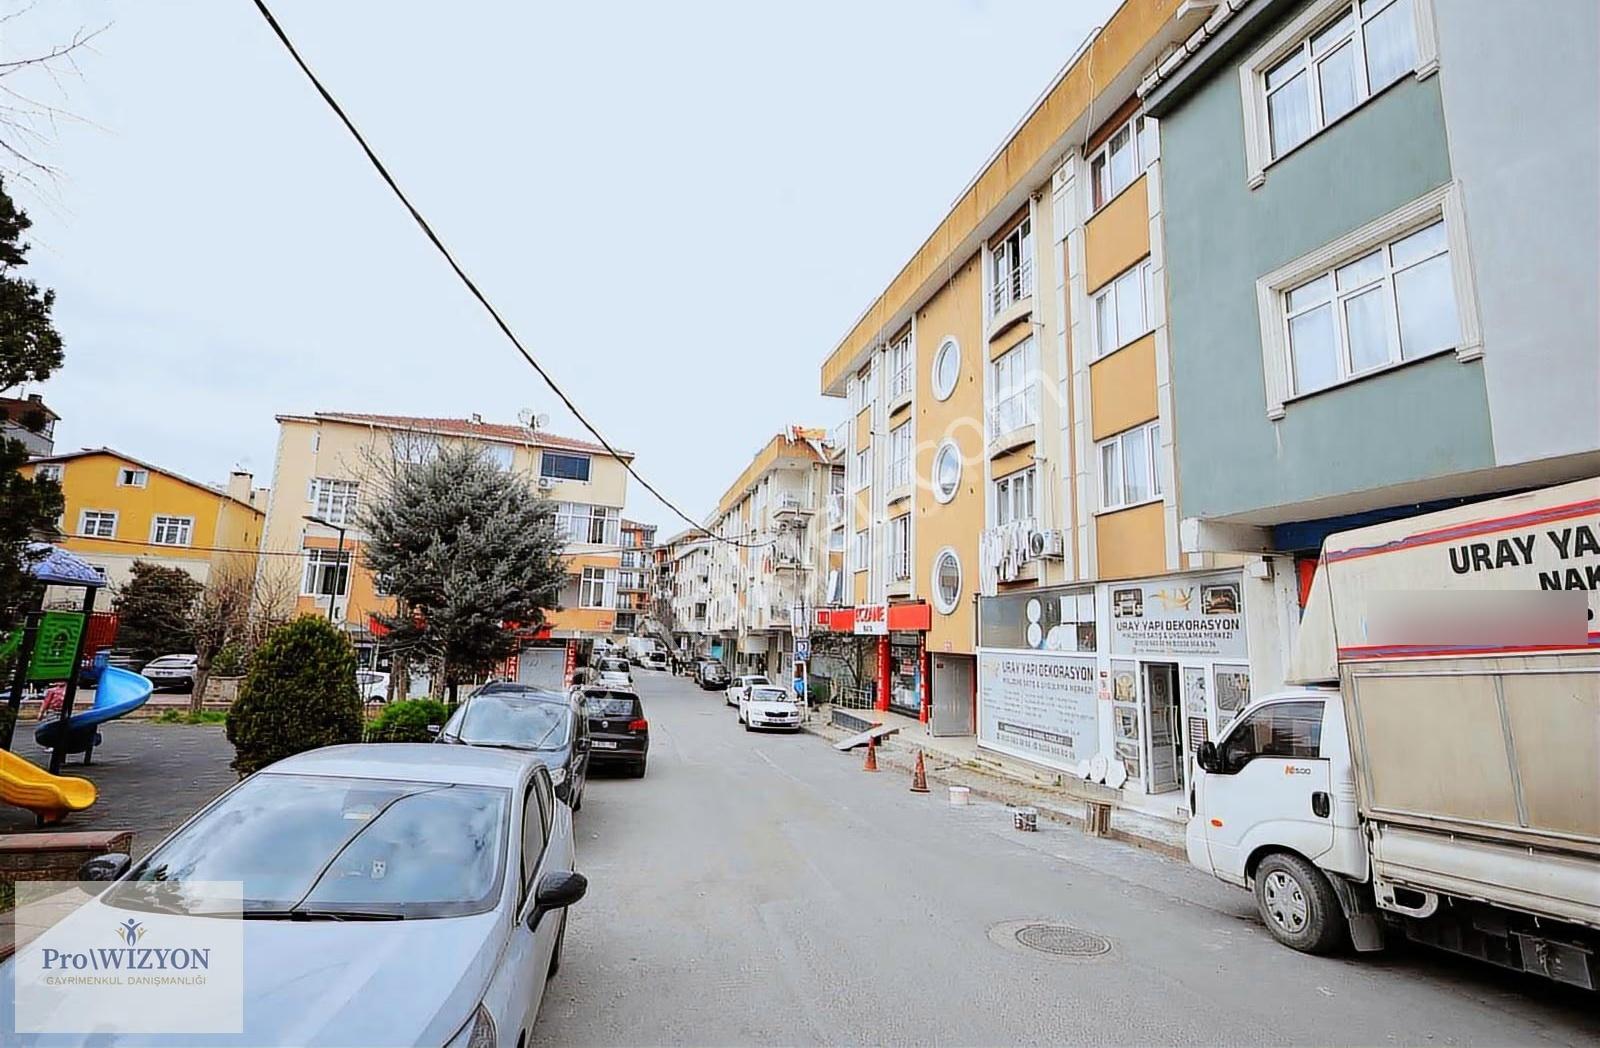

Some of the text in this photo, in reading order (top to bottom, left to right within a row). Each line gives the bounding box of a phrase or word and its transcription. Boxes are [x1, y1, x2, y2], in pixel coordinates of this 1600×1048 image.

[1448, 524, 1600, 575] URAY YA
[1116, 618, 1240, 632] URAY YAPI DEKORASYON
[1038, 664, 1094, 681] DEKORASYON
